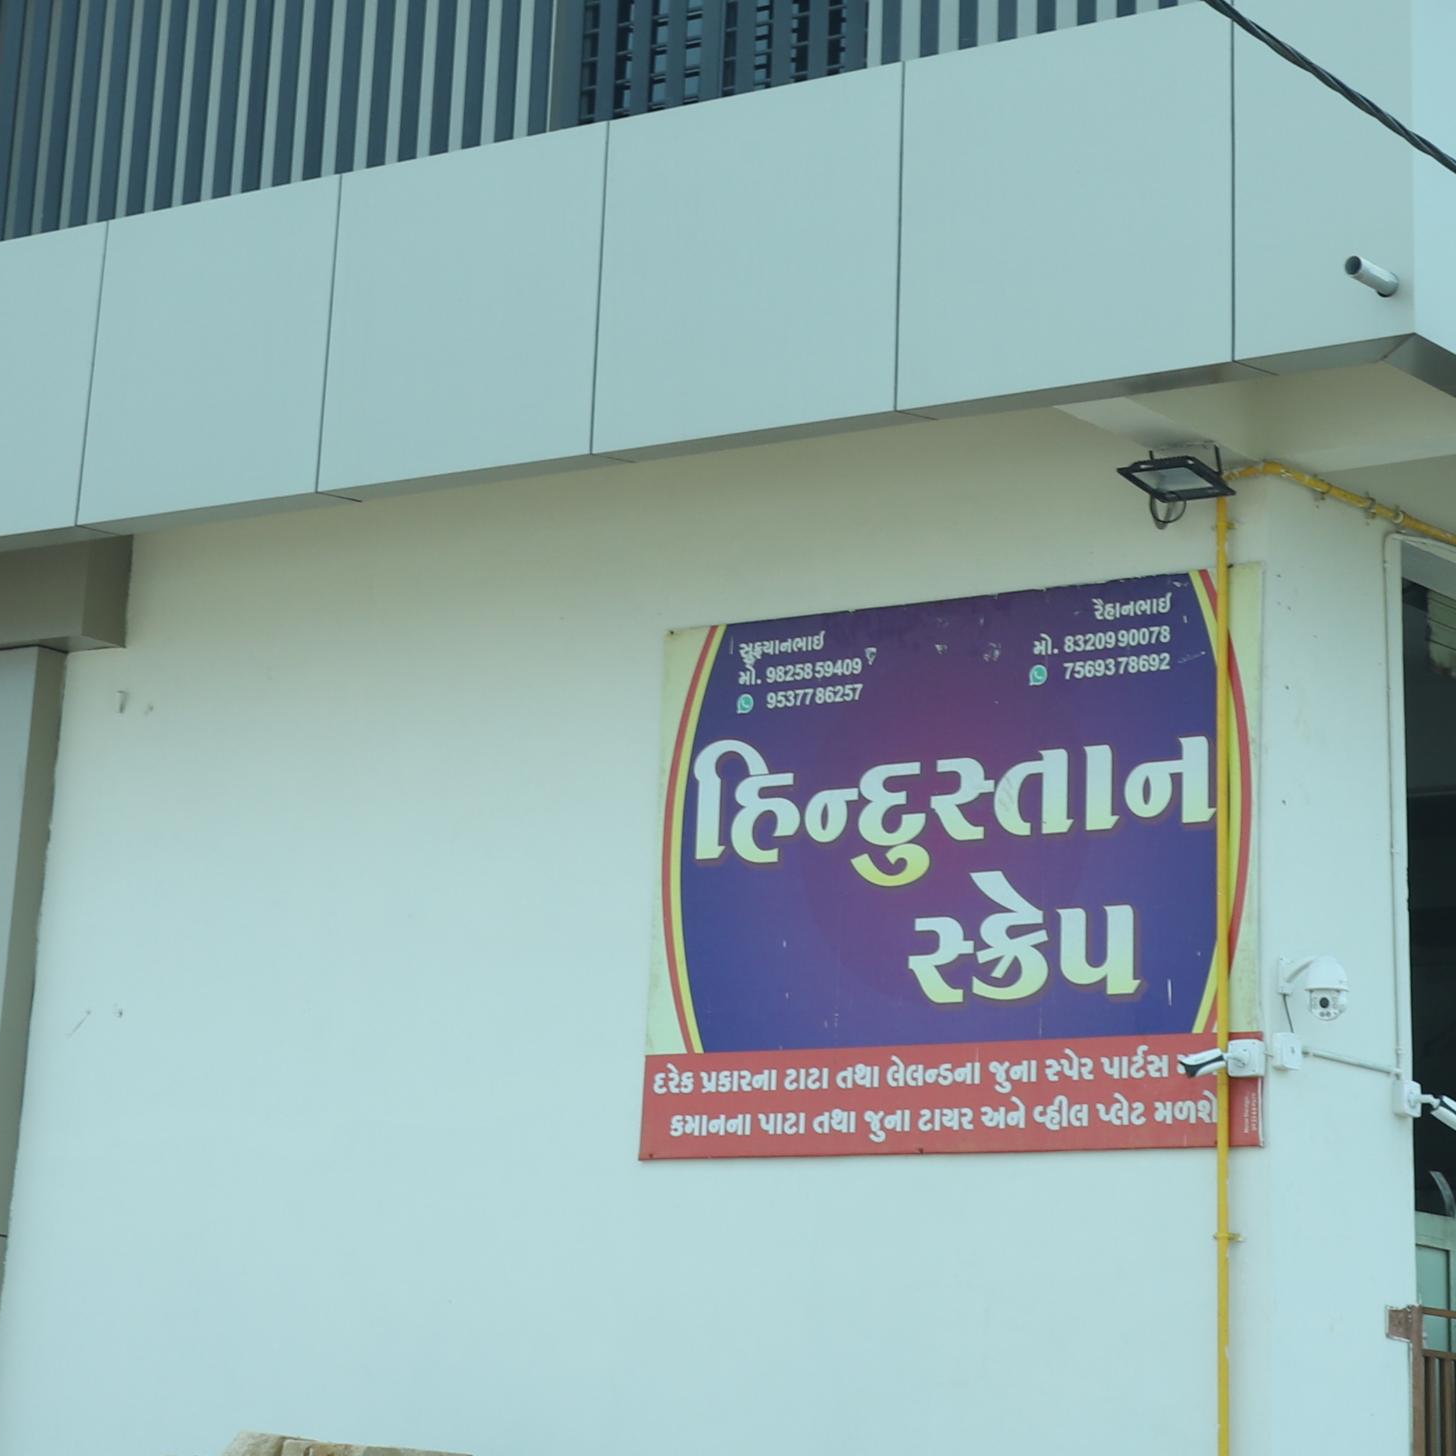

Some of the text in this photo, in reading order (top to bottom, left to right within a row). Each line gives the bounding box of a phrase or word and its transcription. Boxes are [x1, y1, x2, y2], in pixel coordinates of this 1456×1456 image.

[1033, 633, 1059, 655] મો.
[738, 664, 762, 685] મો.
[693, 735, 1217, 887] હિન્દુસ્તાન
[908, 870, 1141, 1003] સ્ક્રેપ
[653, 1063, 694, 1094] દરેક
[700, 1069, 777, 1093] પ્રકારના
[783, 1067, 829, 1091] ટાટા
[836, 1063, 880, 1089] તથા
[886, 1055, 981, 1087] લેલન્ડના
[988, 1060, 1037, 1093] જુના
[1045, 1048, 1094, 1082] સ્પેર
[670, 1113, 751, 1137] કમાનના
[758, 1112, 805, 1135] પાટા
[812, 1108, 856, 1134] તથા
[864, 1109, 911, 1143] જુના
[918, 1107, 974, 1132] ટાયર
[980, 1096, 1026, 1129] અને
[1033, 1095, 1089, 1131] વ્હીલ
[1096, 1092, 1146, 1127] પ્લેટ
[1154, 1090, 1217, 1124] મળશે
